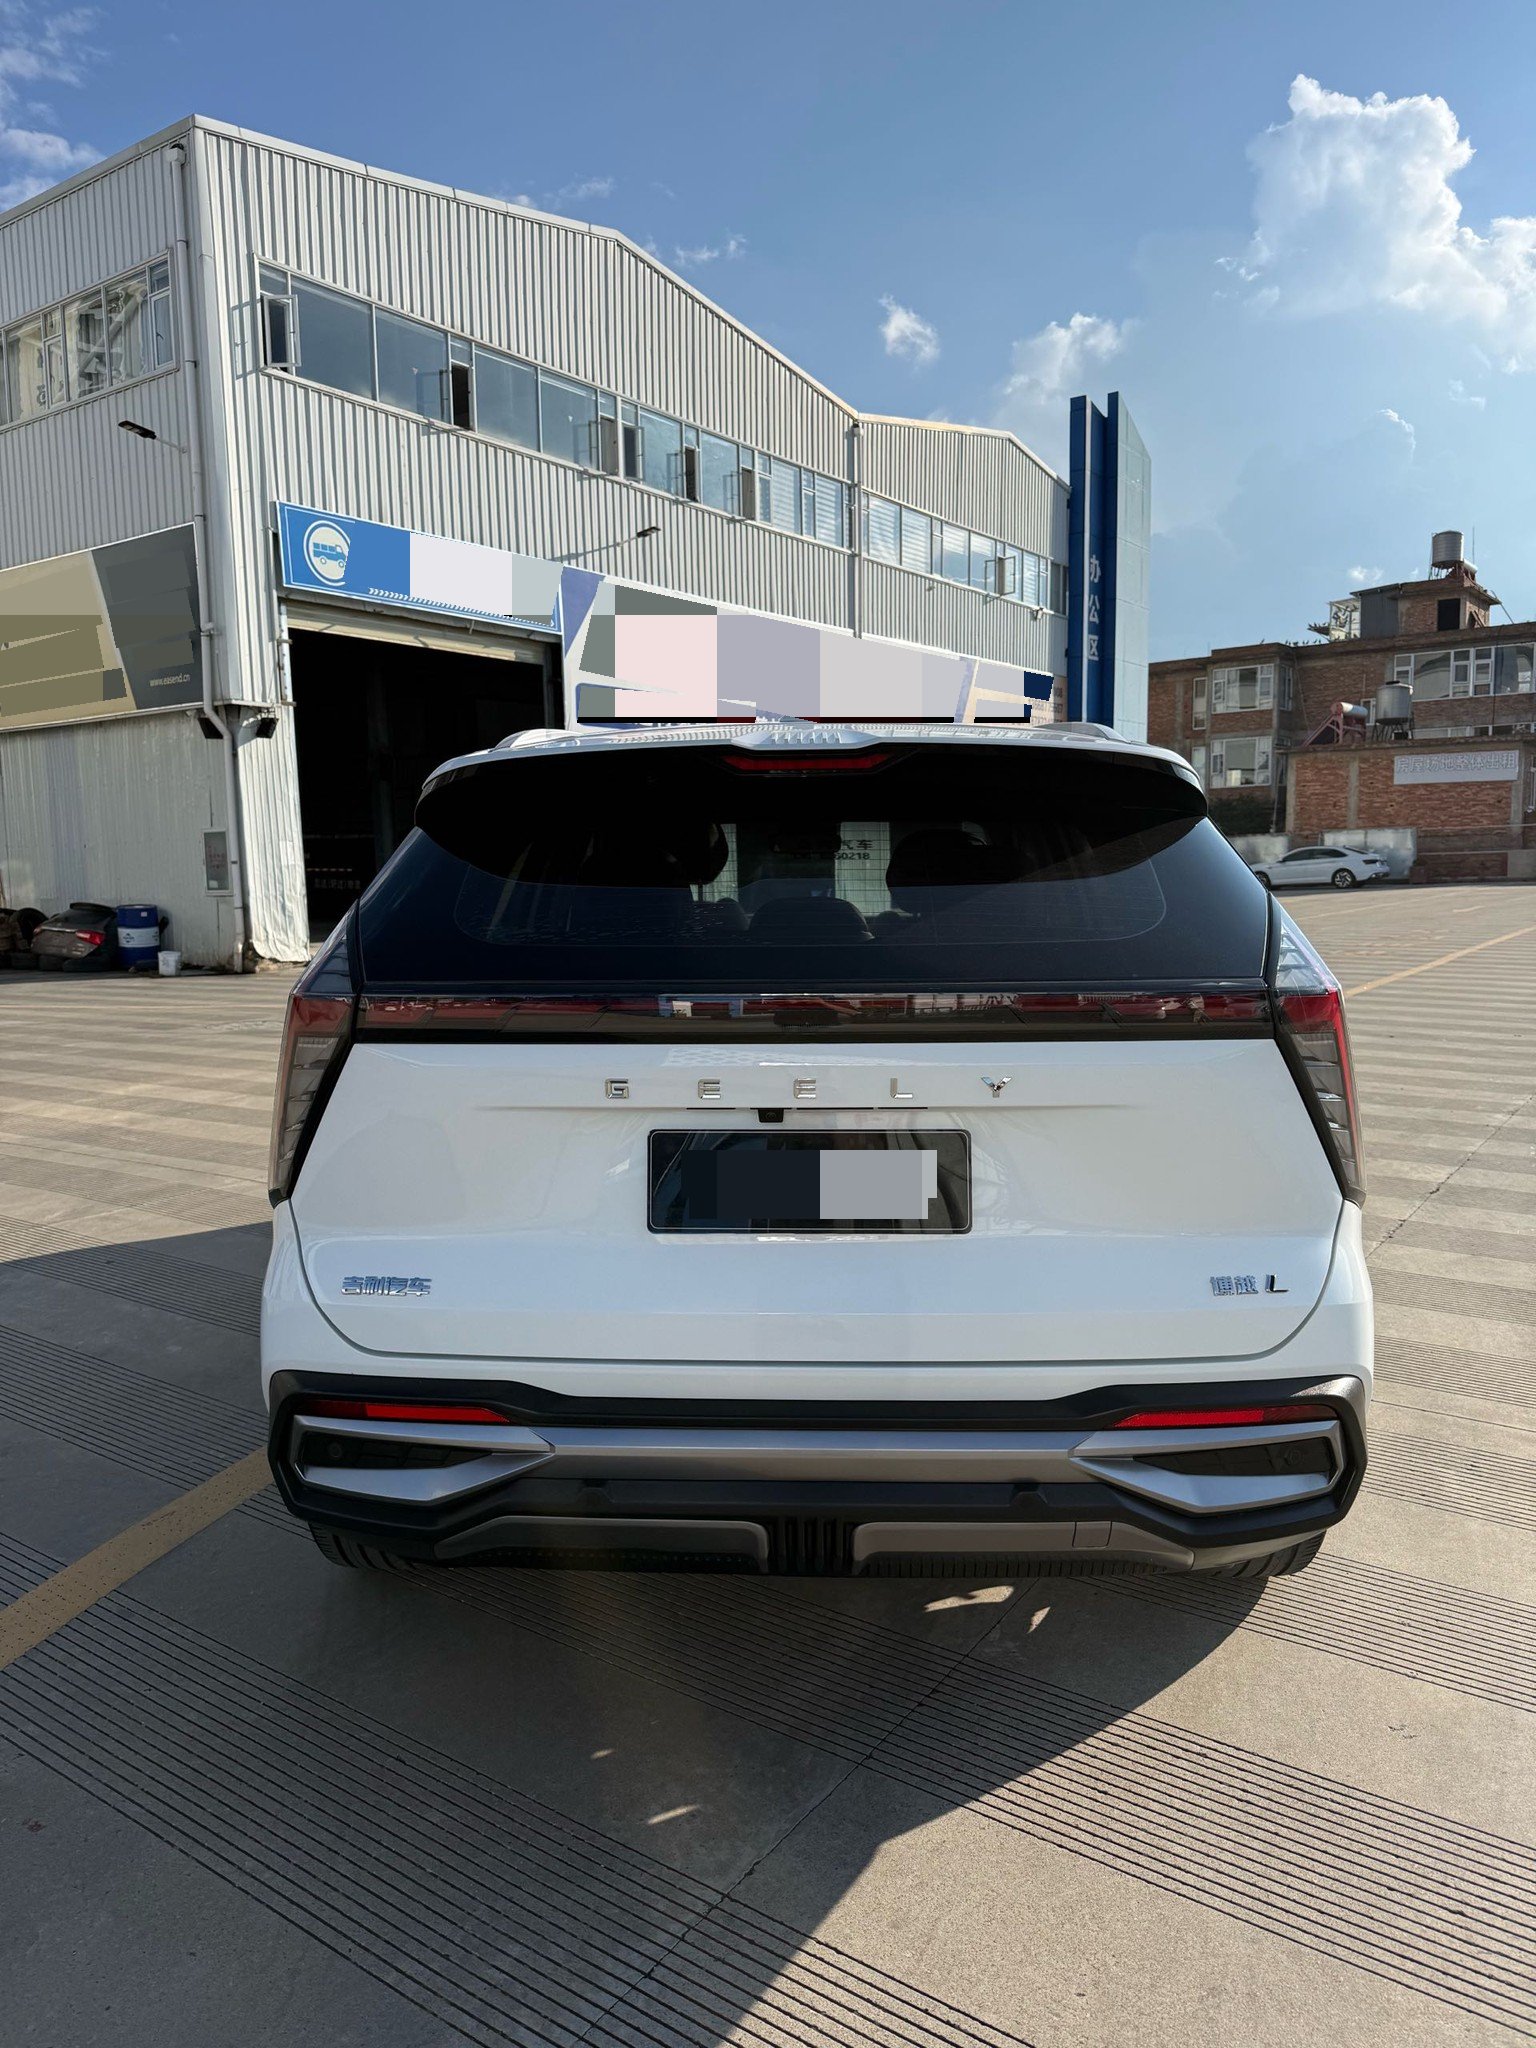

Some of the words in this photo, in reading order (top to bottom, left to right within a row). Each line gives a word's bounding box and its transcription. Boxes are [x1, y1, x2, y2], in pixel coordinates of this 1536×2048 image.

[1088, 554, 1101, 661] 办公区
[1398, 753, 1516, 772] 房屋场地整体出租
[604, 1076, 1013, 1099] GEELY
[341, 1276, 433, 1296] 吉利汽车
[1210, 1276, 1259, 1296] 博越
[1265, 1274, 1290, 1293] L
